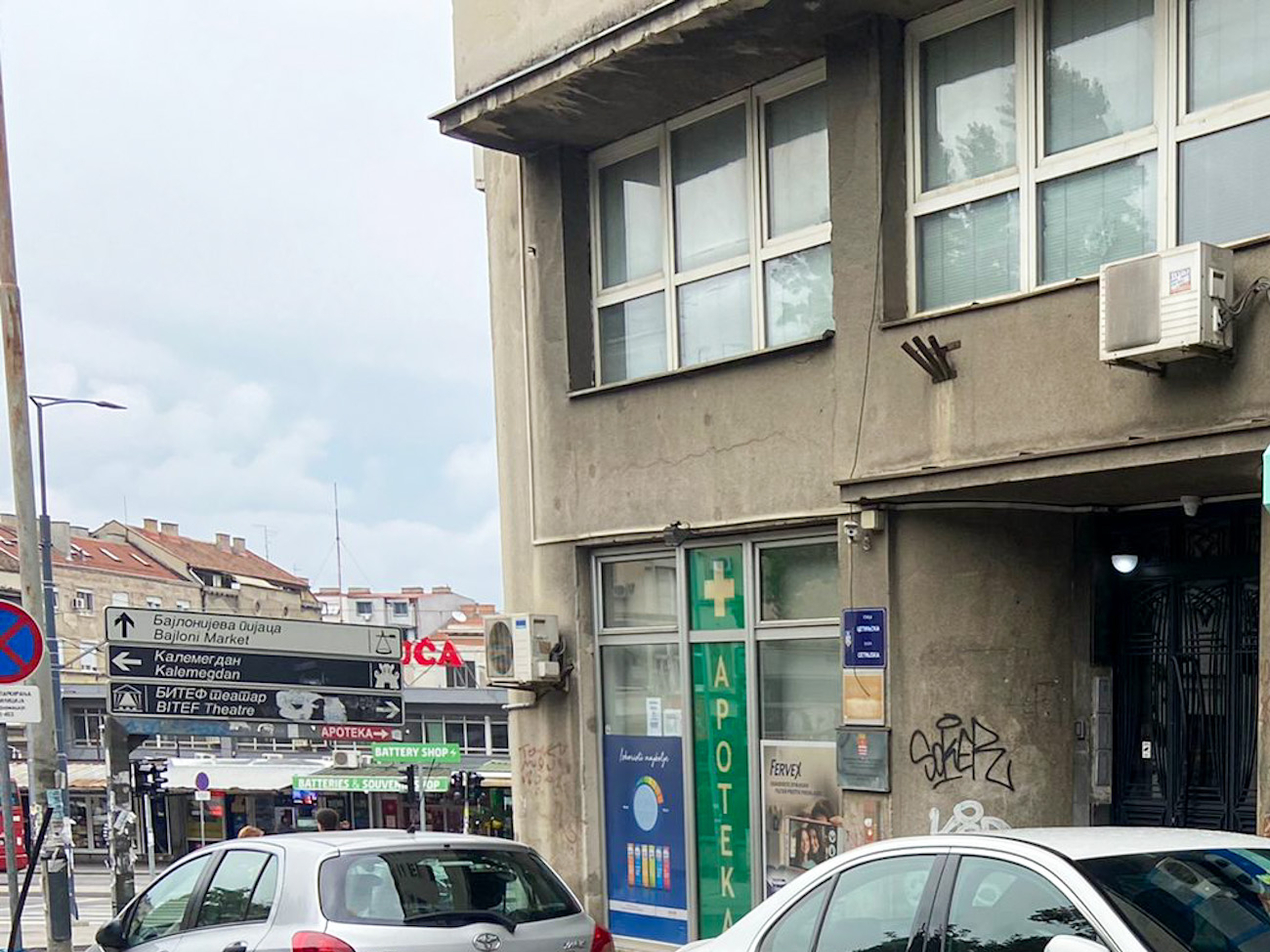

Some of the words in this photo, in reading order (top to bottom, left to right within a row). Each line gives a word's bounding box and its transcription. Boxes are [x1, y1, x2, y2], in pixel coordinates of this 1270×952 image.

[154, 614, 236, 631] Бајлонијева
[154, 629, 200, 645] Bajloni
[204, 632, 250, 646] Market
[154, 650, 242, 667] Калемегдан
[155, 665, 241, 681] Kalemegdan
[156, 686, 208, 700] БИТЕФ
[156, 701, 200, 715] BITEF
[205, 702, 256, 717] Theatre
[321, 726, 374, 739] APOTEKA
[374, 746, 420, 758] BATTERY
[421, 746, 449, 758] SHOP
[298, 776, 349, 788] BATTERIES
